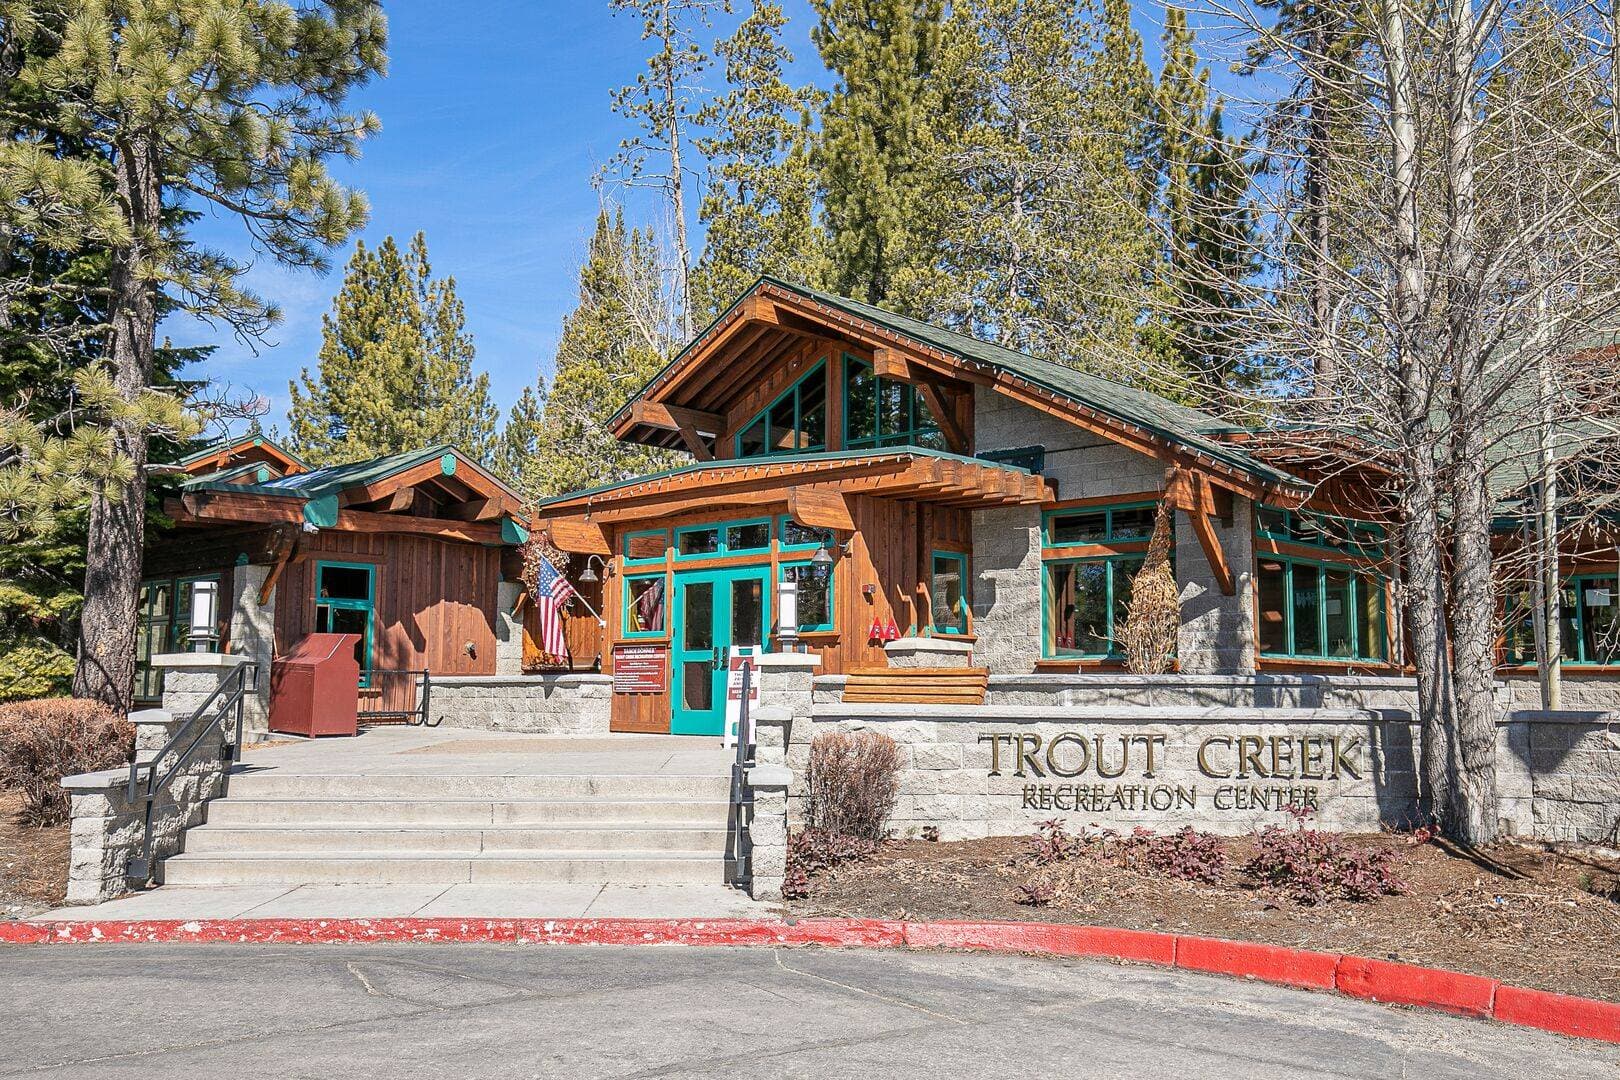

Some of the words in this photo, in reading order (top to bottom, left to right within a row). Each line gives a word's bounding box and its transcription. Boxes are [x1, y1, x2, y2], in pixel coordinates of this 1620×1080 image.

[978, 732, 1167, 779] TROUT
[1197, 735, 1363, 780] CREEK
[1021, 783, 1197, 812] RECREATION
[1214, 785, 1319, 812] CENTER
